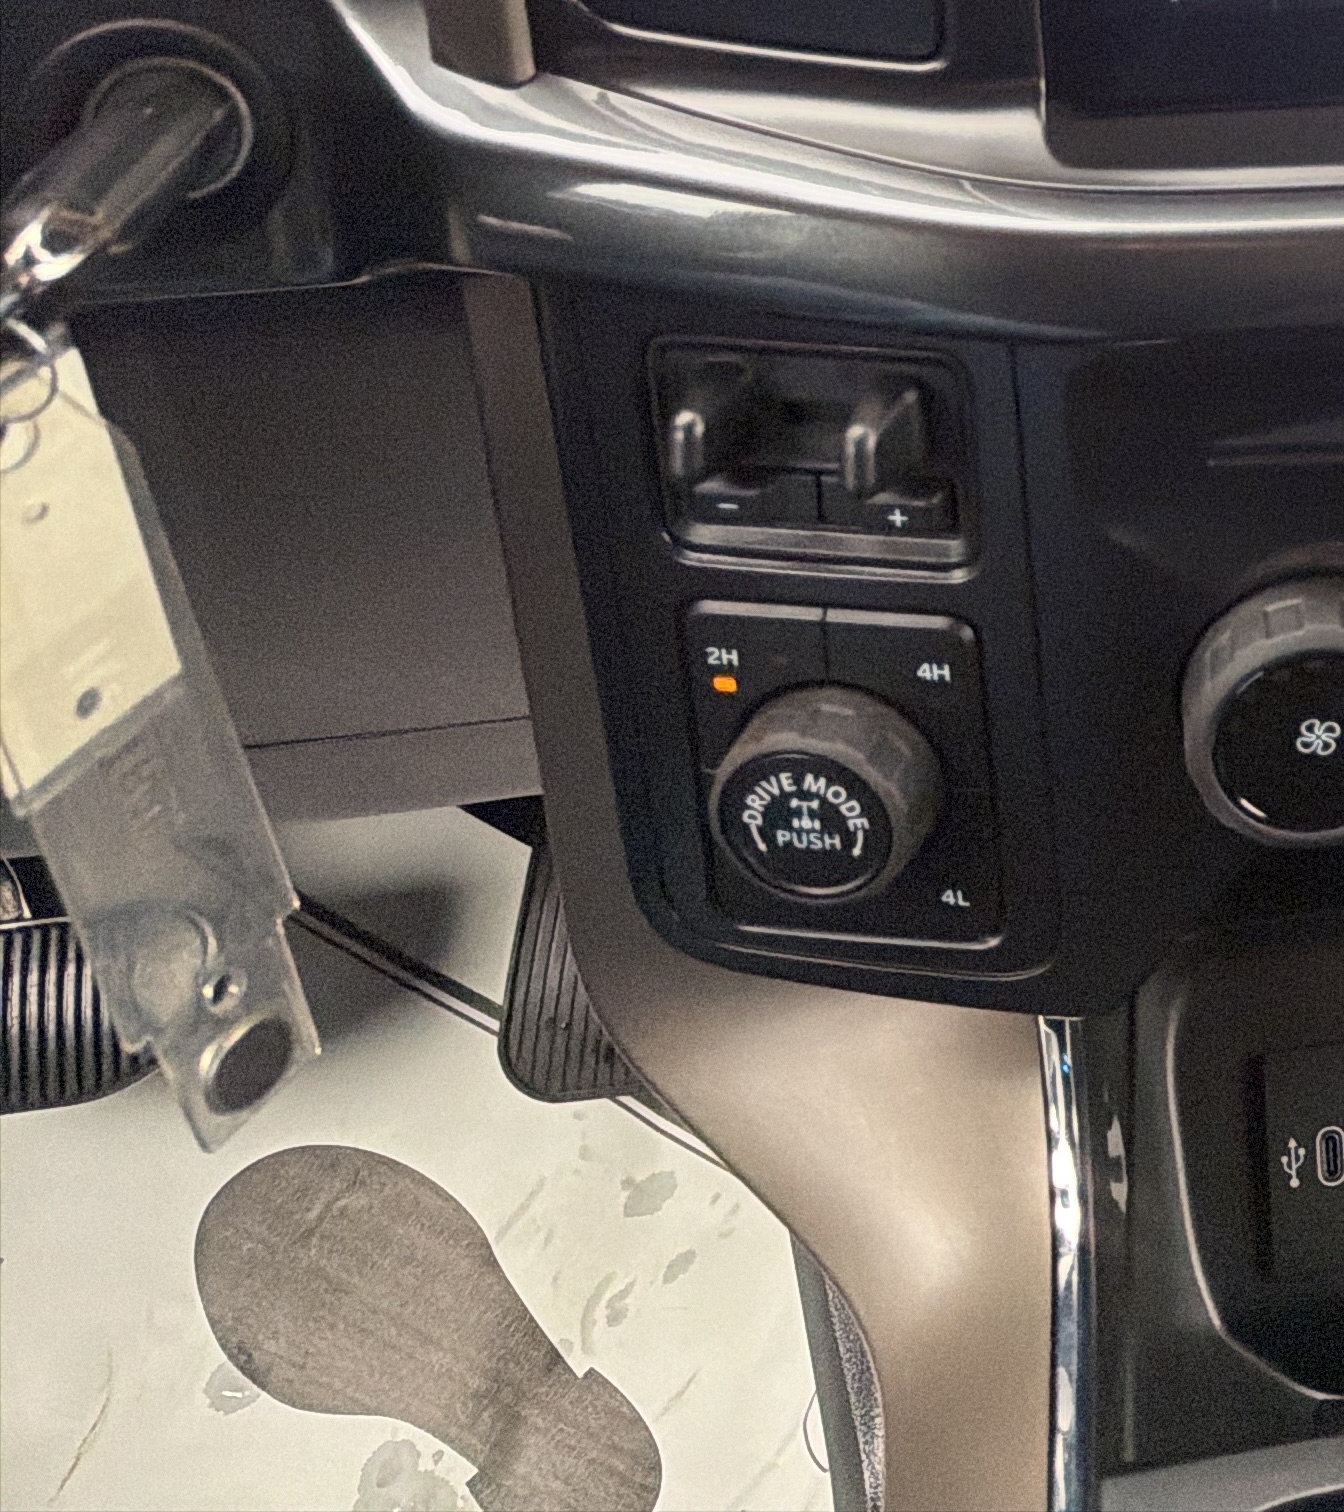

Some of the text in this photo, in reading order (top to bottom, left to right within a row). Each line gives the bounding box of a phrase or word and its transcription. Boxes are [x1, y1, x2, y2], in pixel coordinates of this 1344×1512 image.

[705, 646, 739, 666] 2H
[917, 662, 950, 683] 4H
[742, 772, 869, 832] DRIVE MODE
[776, 828, 841, 851] PUSH
[941, 889, 970, 908] 4L
